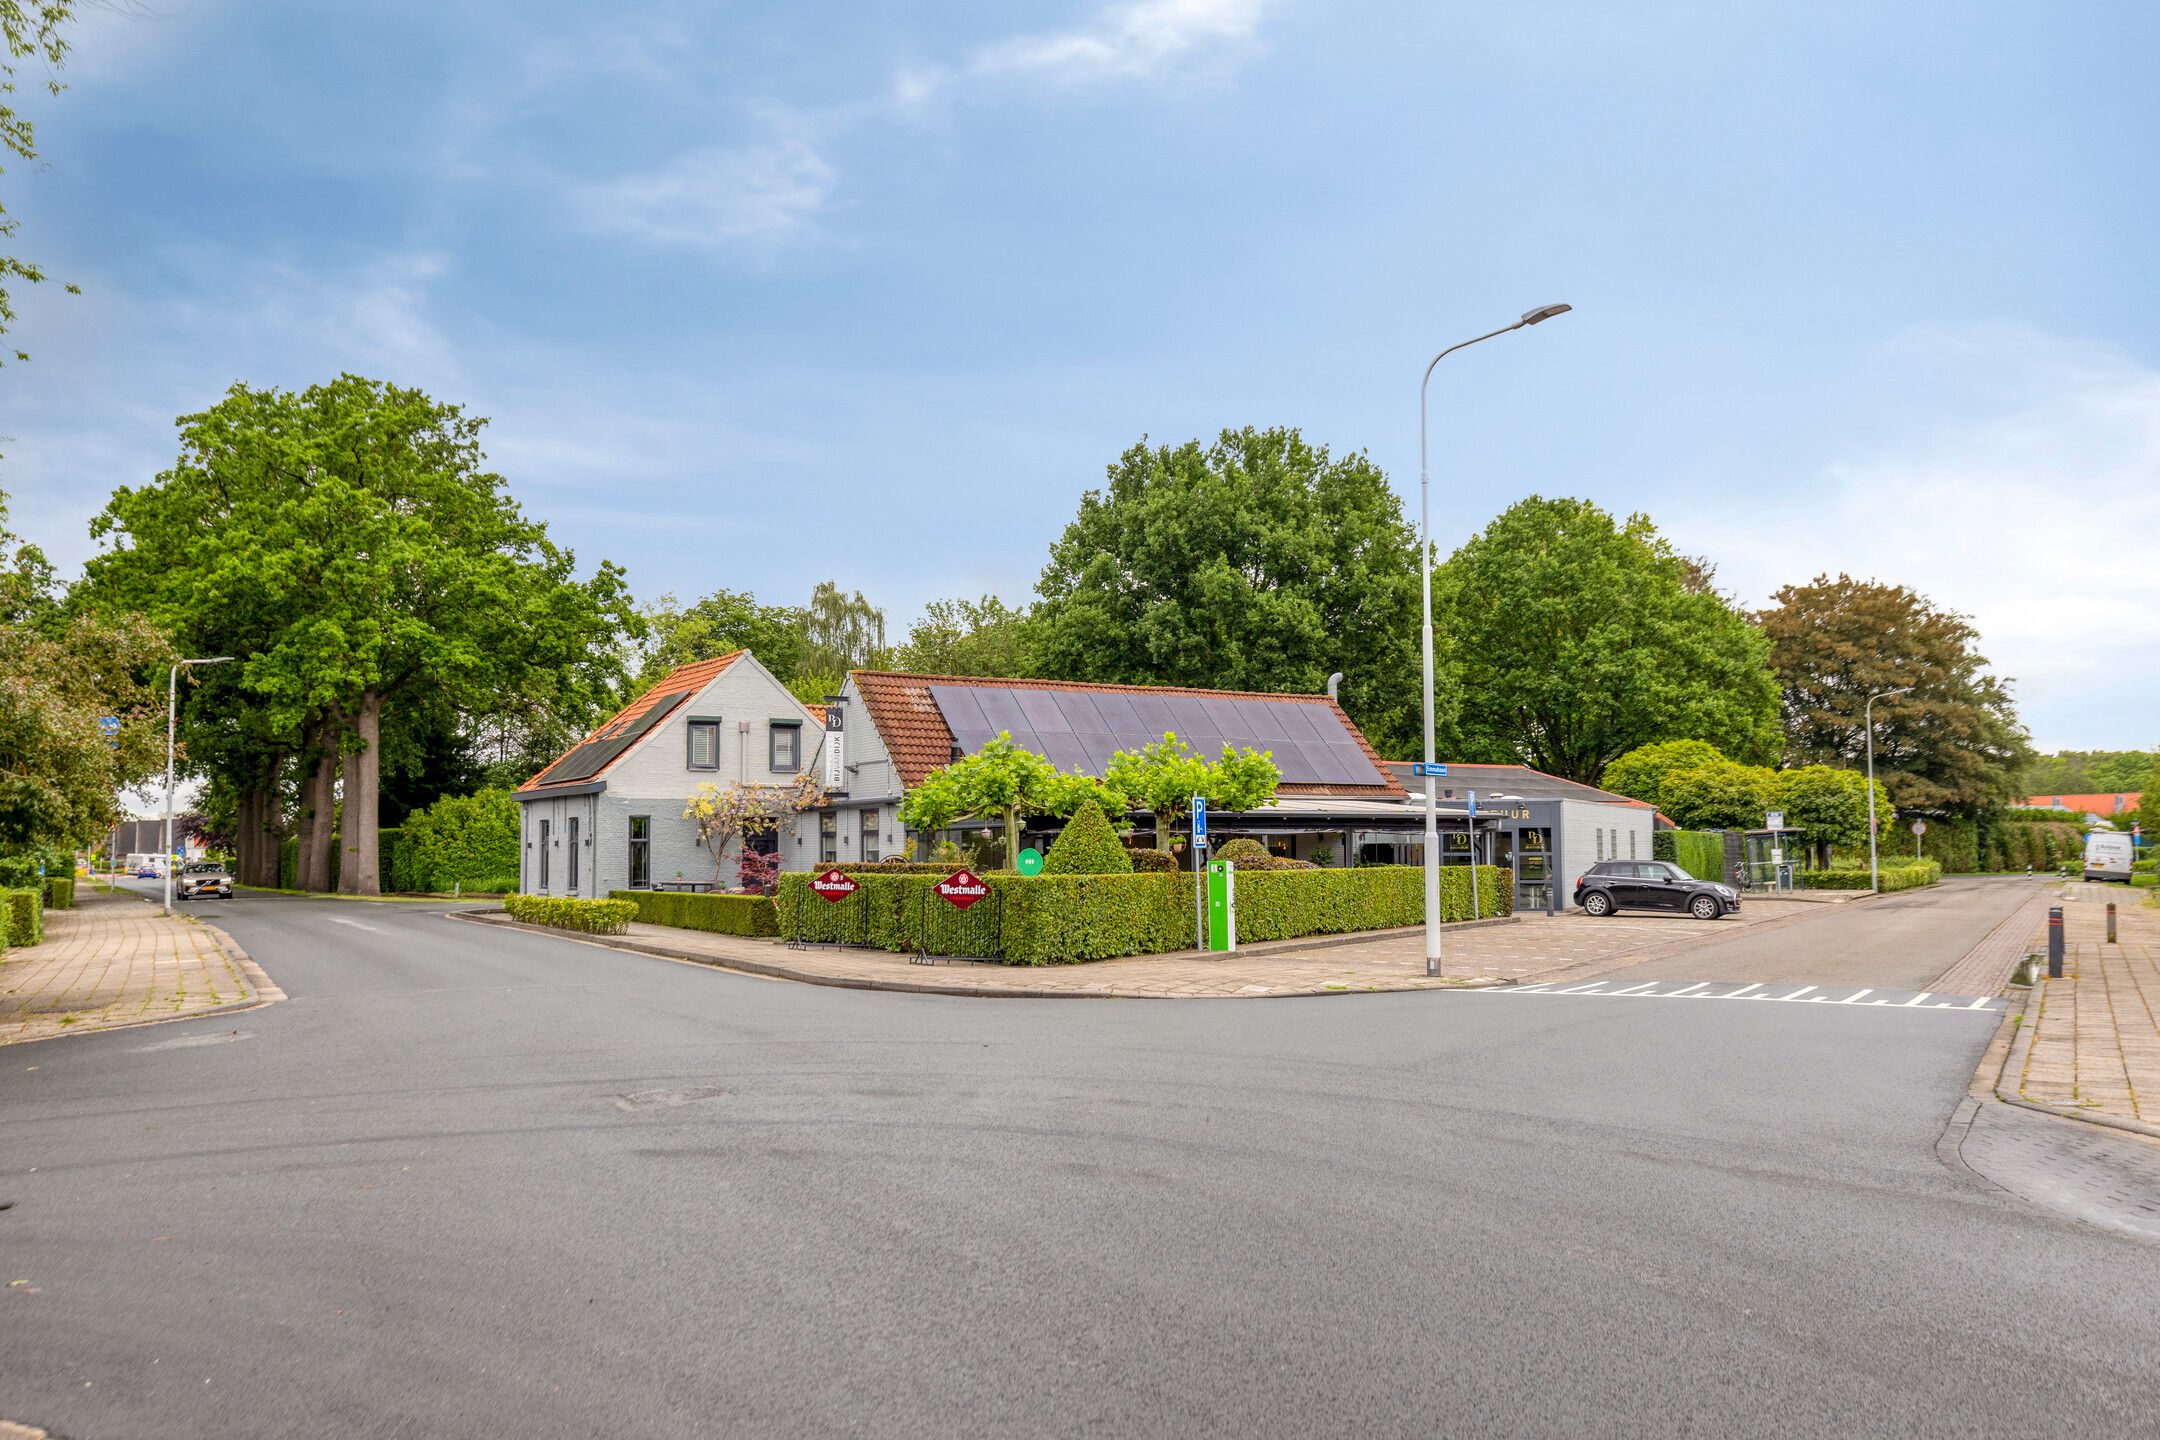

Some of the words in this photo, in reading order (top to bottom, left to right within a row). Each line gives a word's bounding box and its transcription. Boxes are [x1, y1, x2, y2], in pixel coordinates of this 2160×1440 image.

[1197, 801, 1203, 819] P
[814, 881, 855, 891] Westmalle
[940, 884, 986, 895] Westmalle
